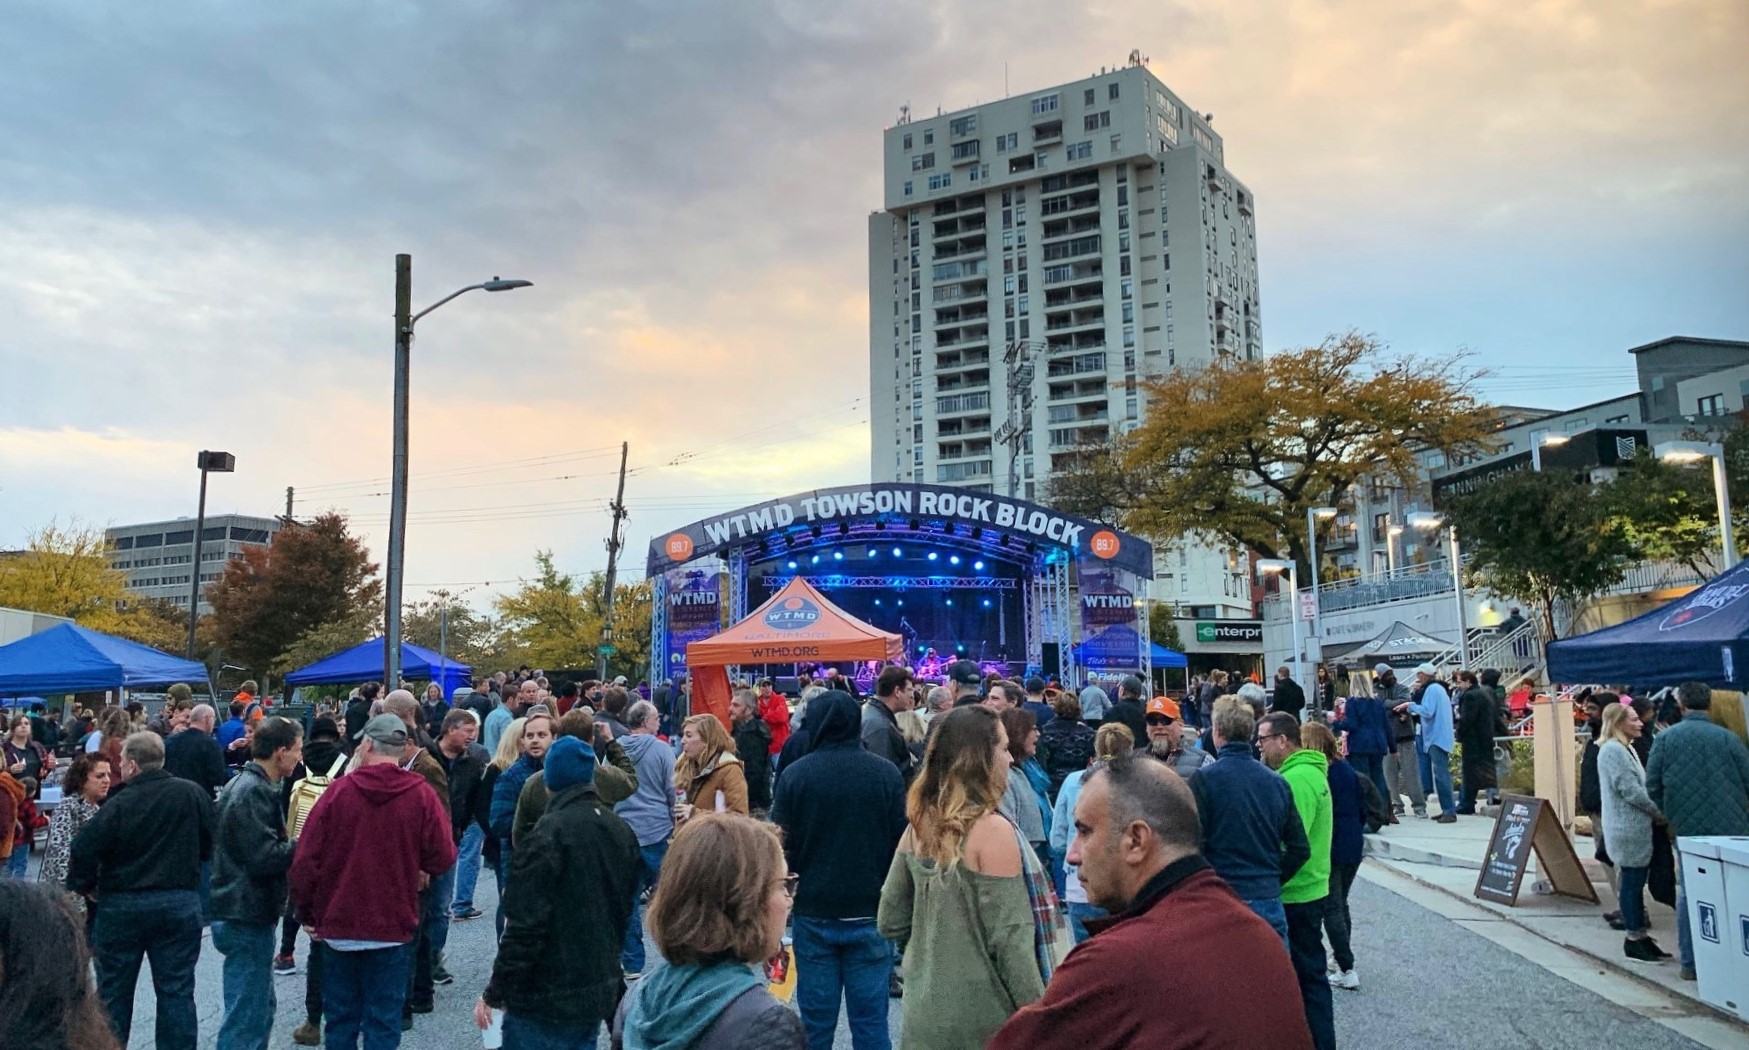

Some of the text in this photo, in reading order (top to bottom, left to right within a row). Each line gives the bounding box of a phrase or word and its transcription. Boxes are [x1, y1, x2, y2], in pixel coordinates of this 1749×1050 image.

[704, 490, 1084, 546] WTMD TOWSON ROCK BLOCK
[671, 540, 688, 553] 89.7
[1096, 538, 1114, 551] 89.7
[671, 592, 717, 605] WTMD
[1083, 595, 1133, 608] WTMD
[769, 612, 816, 620] WTMD
[751, 646, 819, 658] WTMD.ORG
[1097, 672, 1131, 681] Fideli
